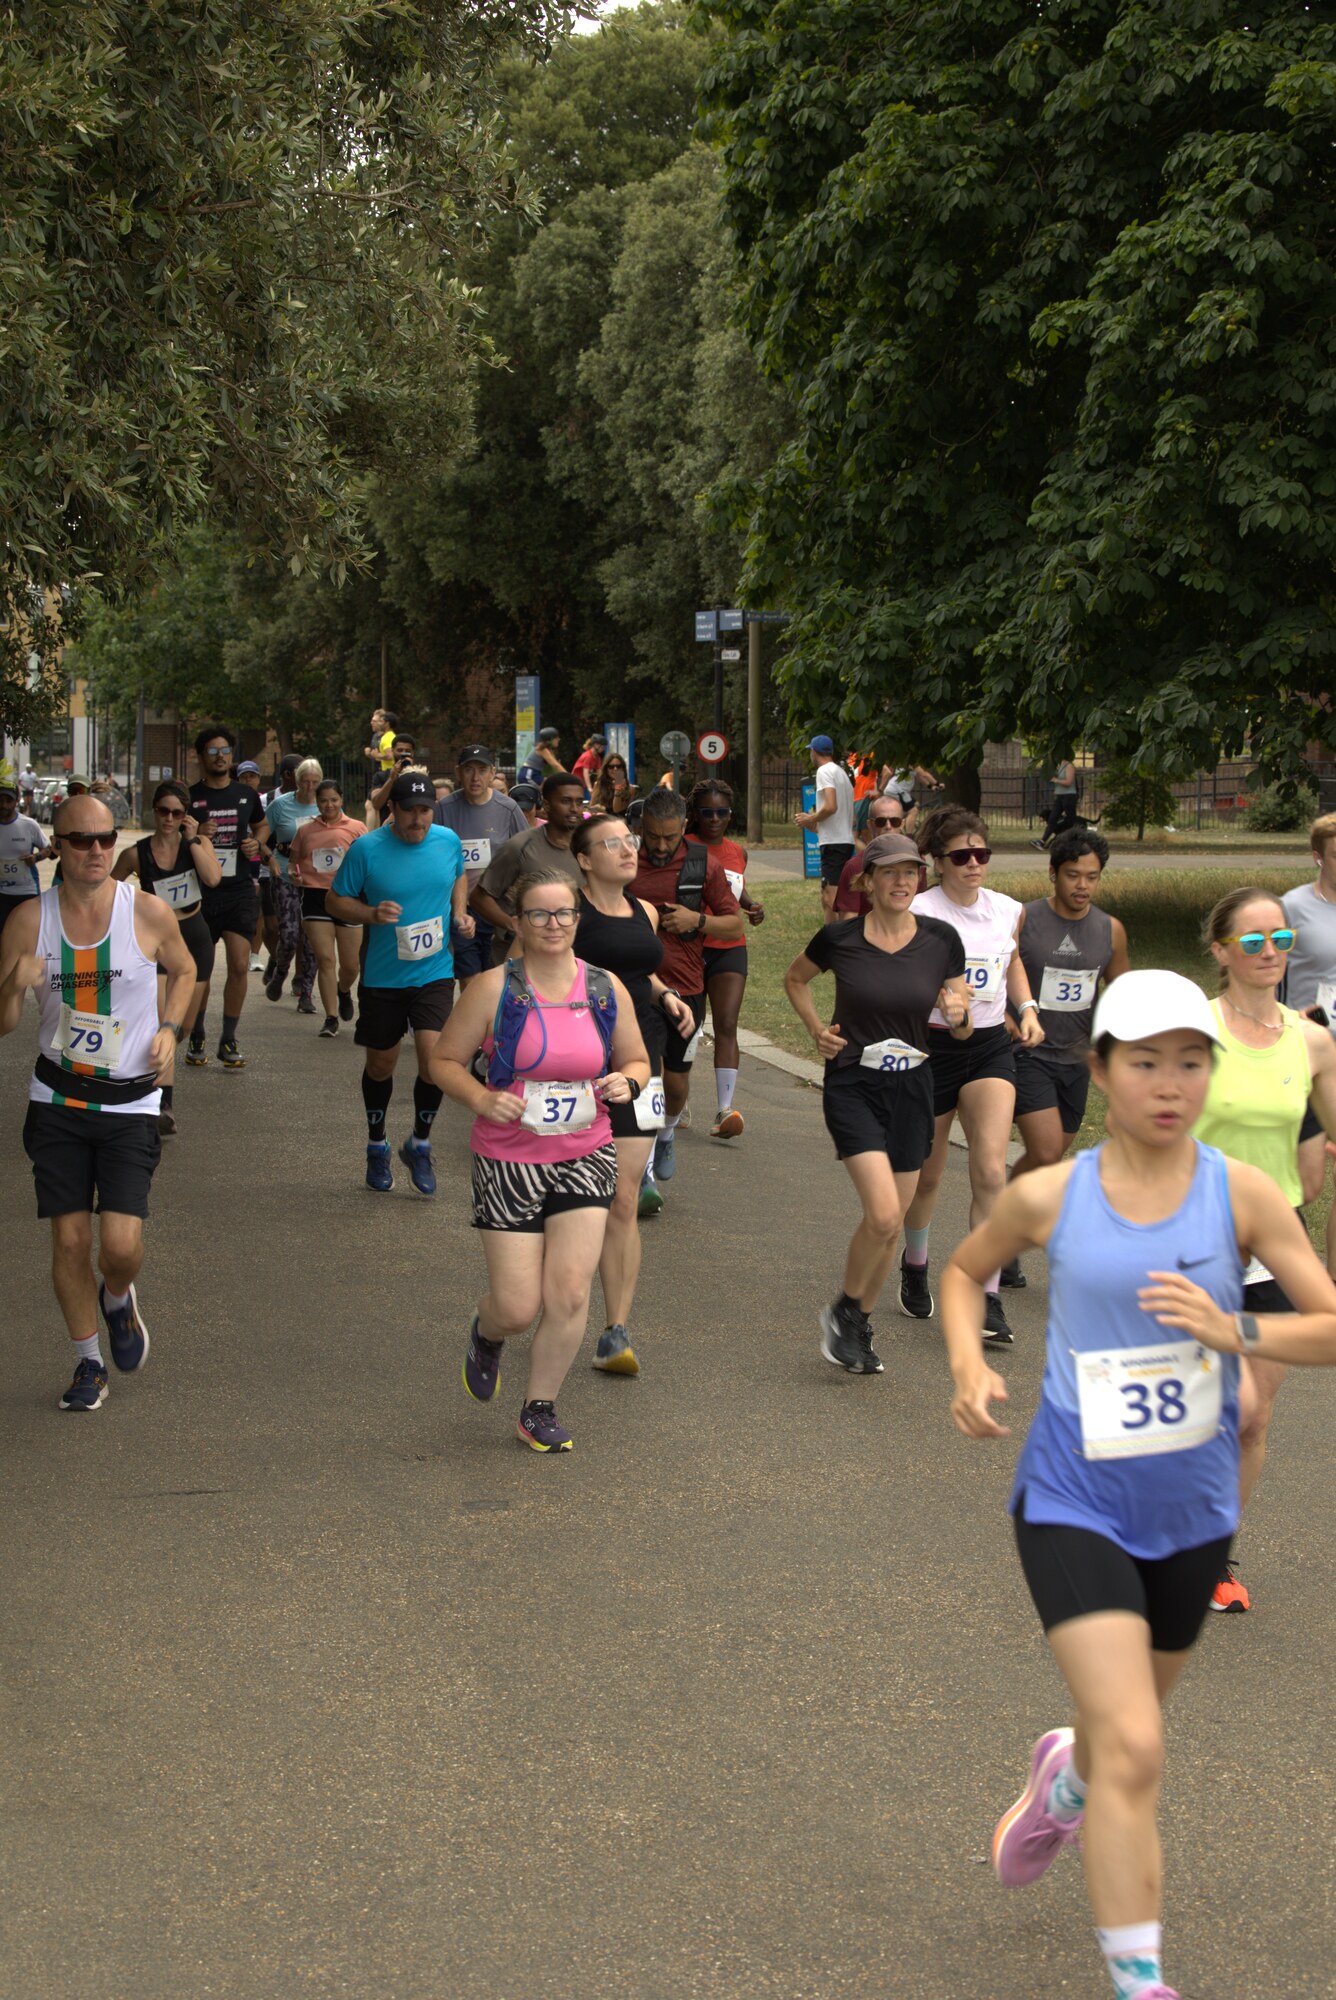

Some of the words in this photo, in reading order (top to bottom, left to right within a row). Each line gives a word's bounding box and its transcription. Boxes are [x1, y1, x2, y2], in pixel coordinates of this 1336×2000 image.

[708, 741, 717, 754] 5
[326, 854, 334, 866] 9
[462, 848, 480, 862] 26
[4, 864, 18, 874] 56
[168, 883, 188, 902] 77
[410, 932, 432, 952] 70
[51, 969, 122, 982] MORNINGTON
[964, 968, 988, 988] 19
[50, 980, 98, 990] CHASERS
[1056, 982, 1082, 1002] 33
[74, 1016, 104, 1025] AFFORDABLE
[70, 1026, 102, 1052] 79
[879, 1054, 909, 1072] 80
[542, 1098, 577, 1122] 37
[1118, 1379, 1188, 1430] 38
